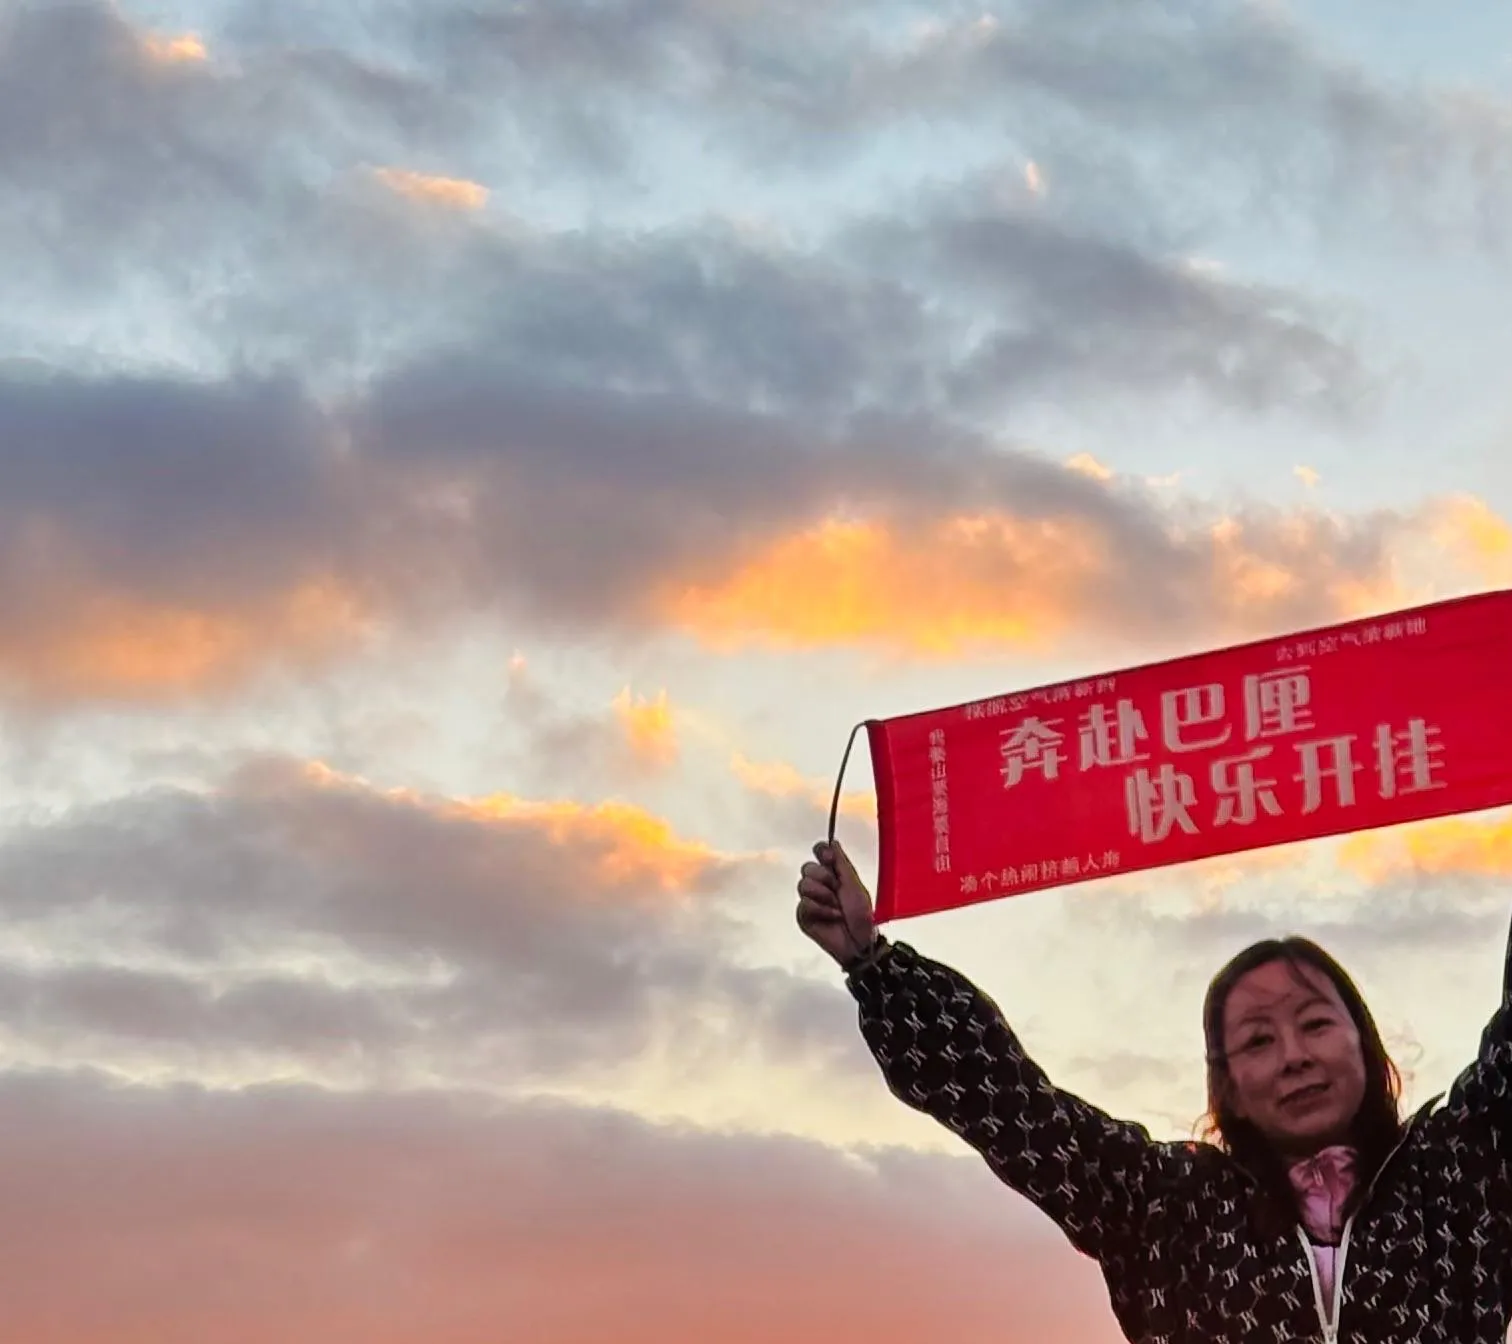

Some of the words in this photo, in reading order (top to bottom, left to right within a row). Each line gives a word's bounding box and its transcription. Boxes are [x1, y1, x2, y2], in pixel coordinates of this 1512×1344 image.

[1000, 664, 1317, 789] 奔赴巴厘
[1123, 718, 1449, 845] 快乐开挂
